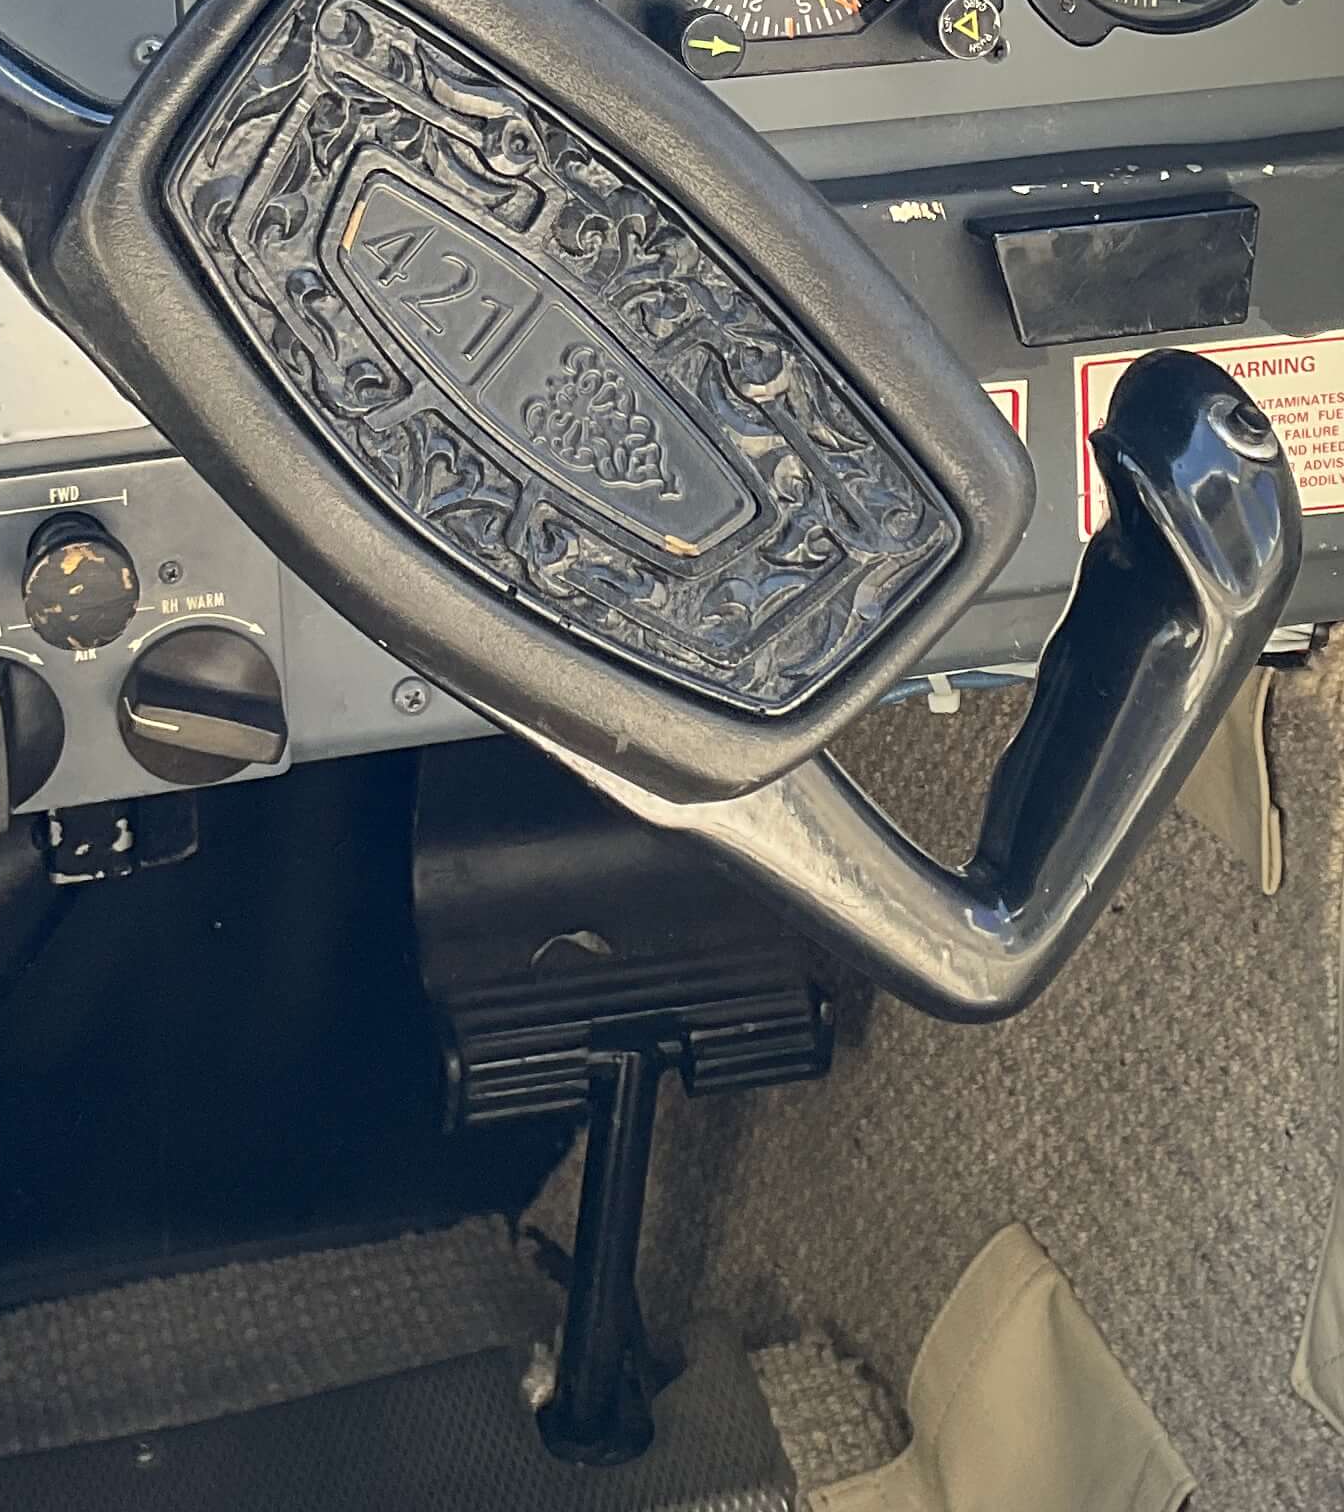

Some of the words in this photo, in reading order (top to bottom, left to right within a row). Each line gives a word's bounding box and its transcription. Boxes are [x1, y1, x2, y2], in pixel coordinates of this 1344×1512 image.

[1227, 356, 1316, 378] ARNING
[1271, 413, 1309, 425] FROM
[1285, 426, 1339, 440] FAILURE
[49, 486, 80, 504] FWD
[162, 599, 179, 614] RH
[186, 592, 225, 610] WARM
